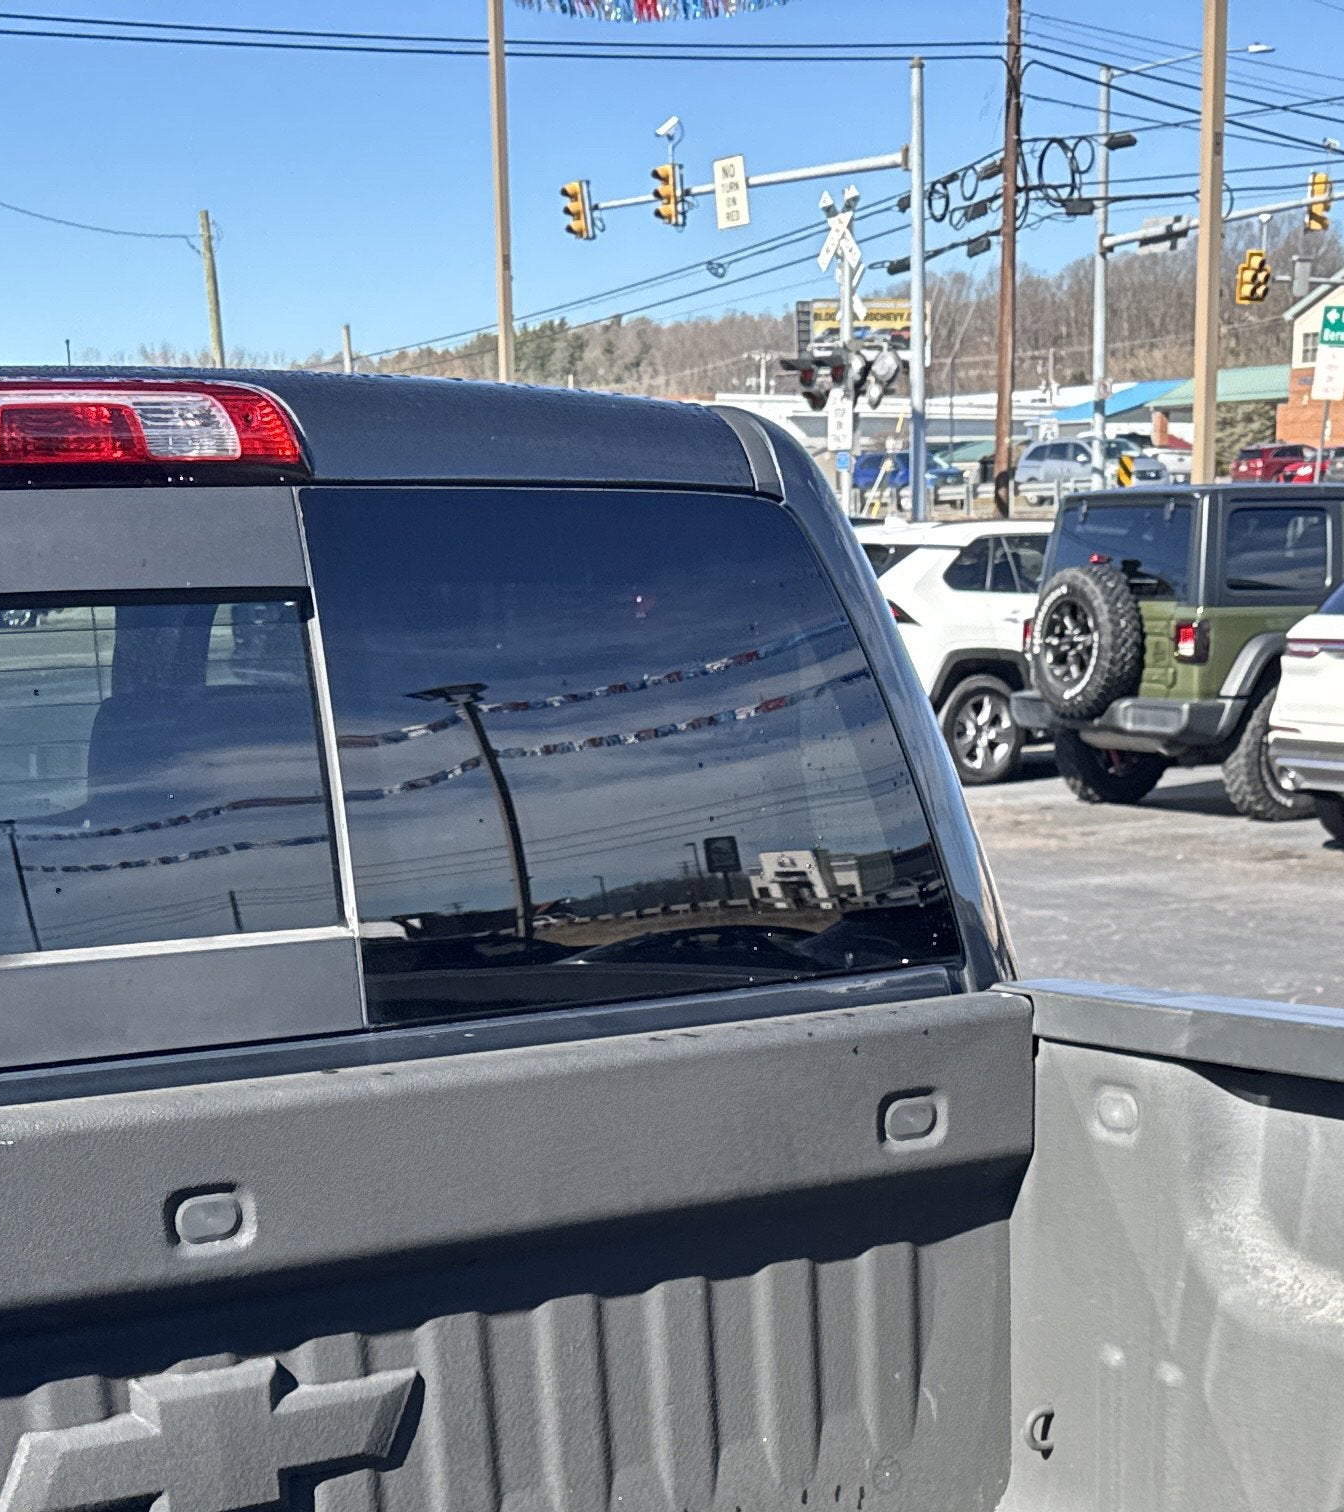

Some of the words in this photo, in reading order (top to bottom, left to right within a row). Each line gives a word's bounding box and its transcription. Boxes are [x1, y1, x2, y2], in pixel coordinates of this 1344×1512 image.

[721, 164, 736, 179] NO
[721, 182, 739, 194] TURN
[726, 196, 737, 208] ON
[726, 209, 740, 222] RED
